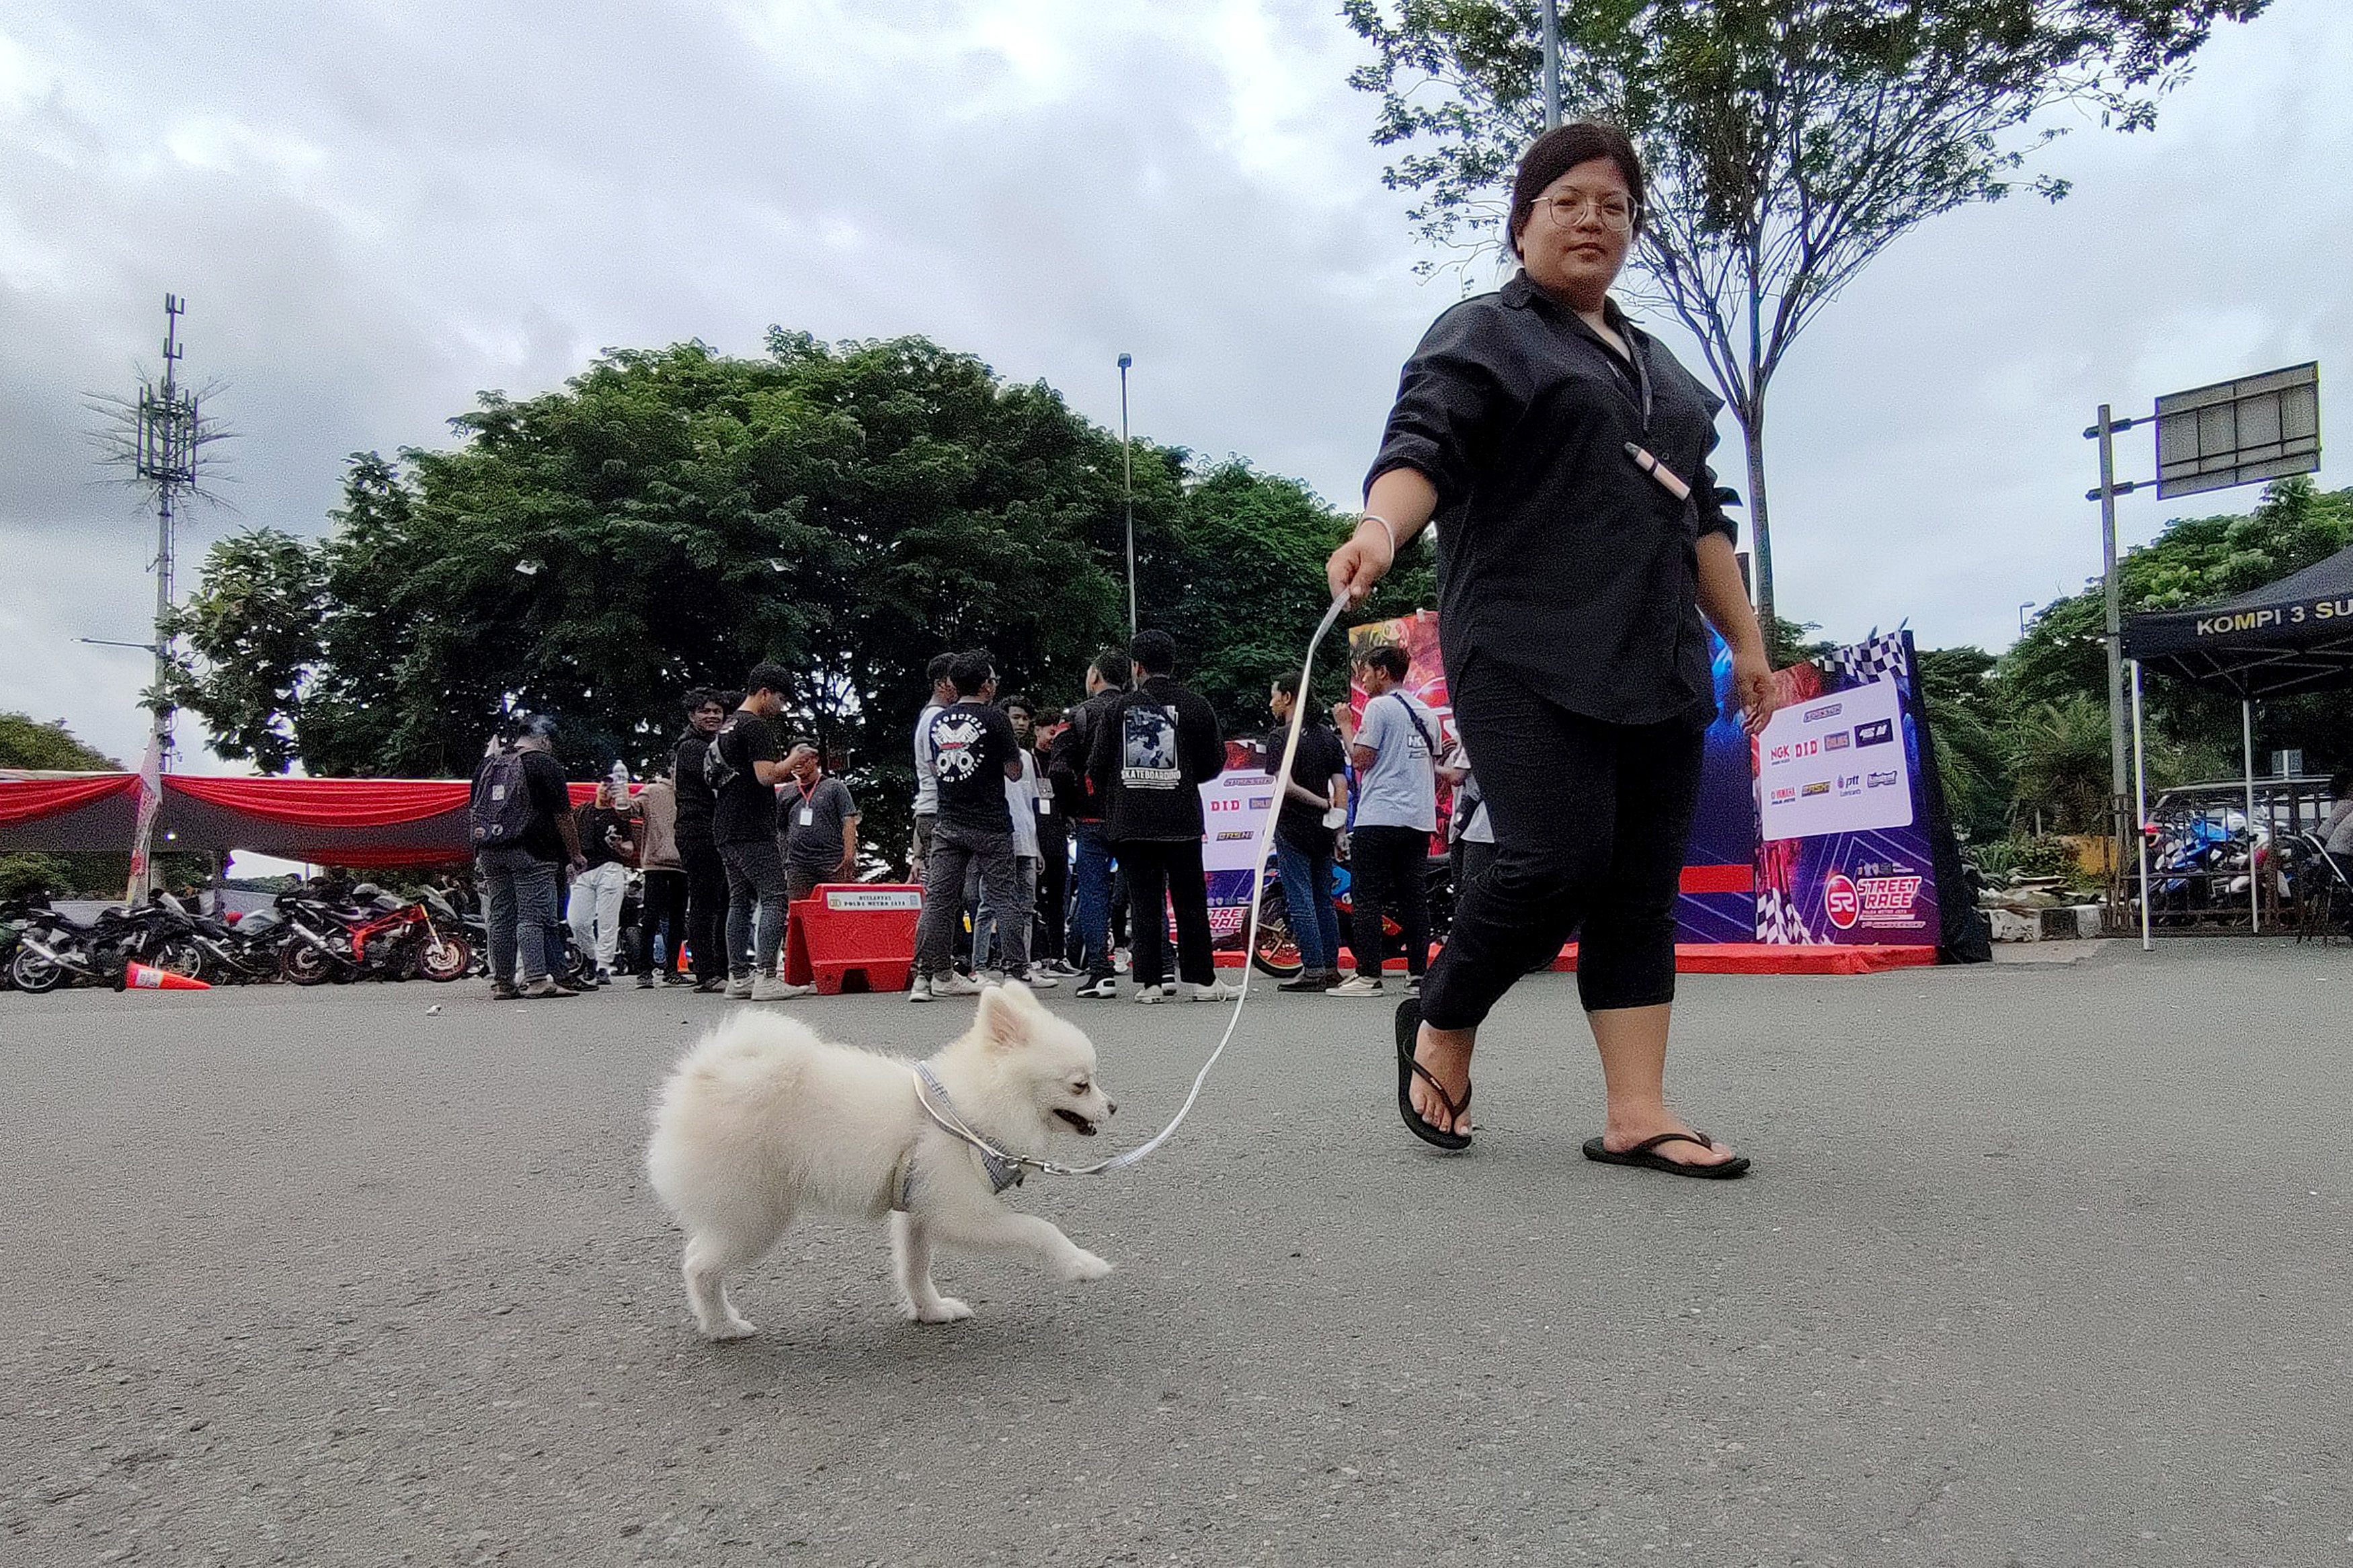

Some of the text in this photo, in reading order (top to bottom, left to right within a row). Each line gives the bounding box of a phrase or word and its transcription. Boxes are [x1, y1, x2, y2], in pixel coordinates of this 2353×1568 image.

[2196, 609, 2282, 636] KOMPI
[2290, 606, 2306, 622] 3
[1770, 745, 1790, 760] NGK
[1121, 770, 1181, 780] SKATEBOARDING
[1845, 775, 1860, 788] ptt
[1858, 877, 1920, 895] STREET
[1866, 893, 1913, 908] RACE
